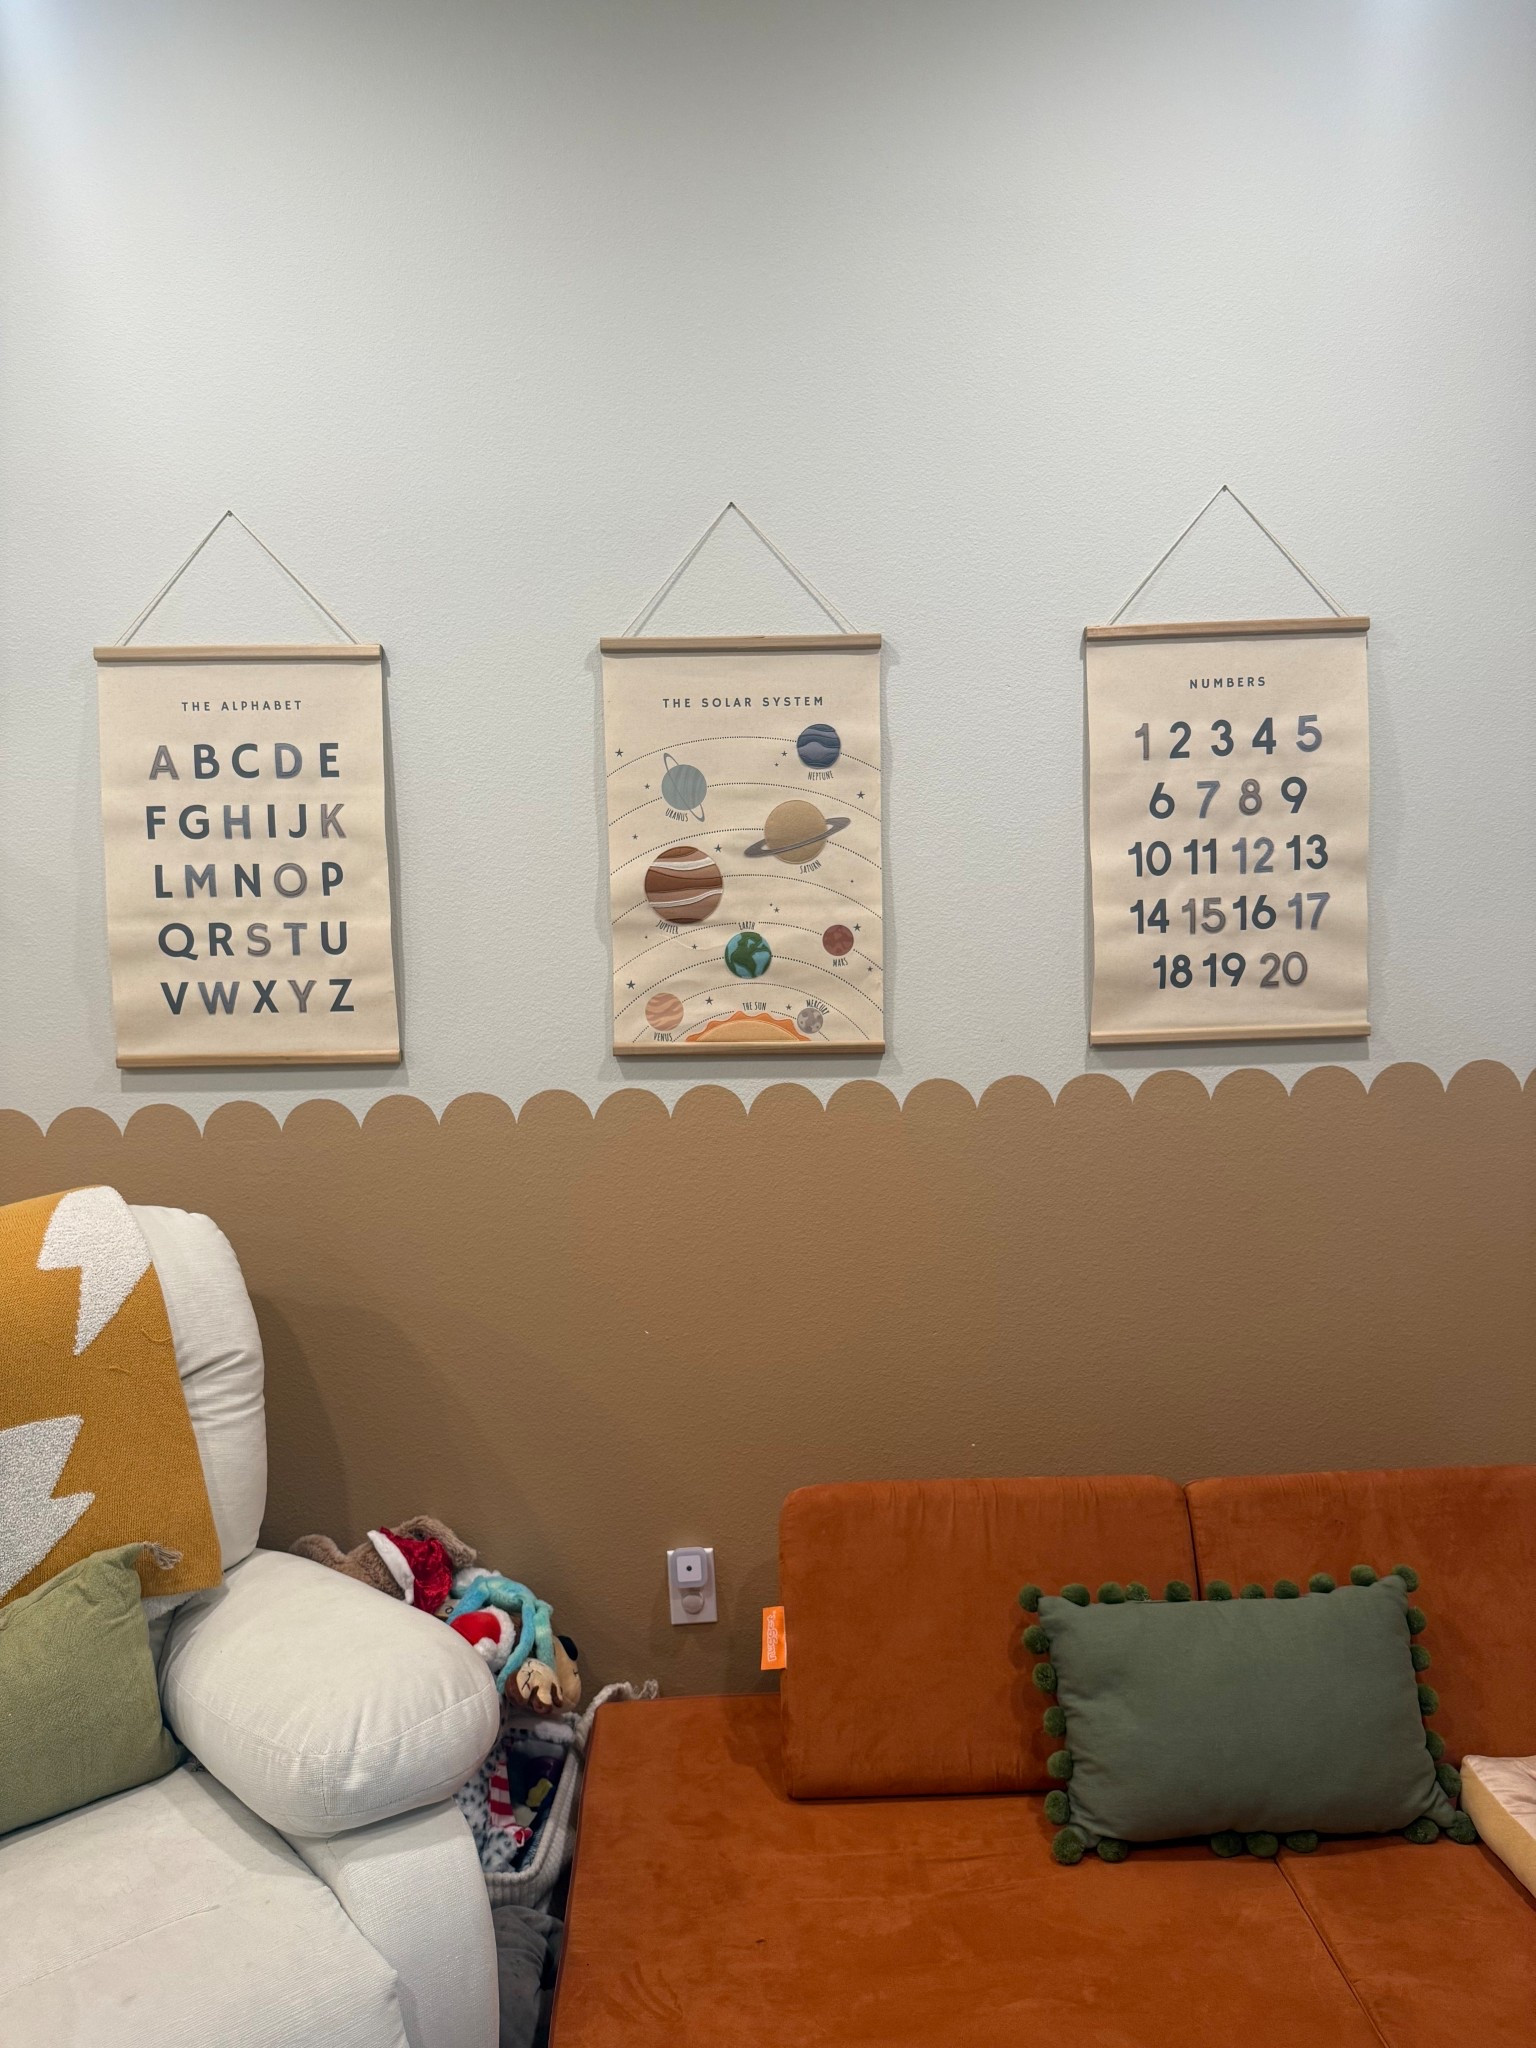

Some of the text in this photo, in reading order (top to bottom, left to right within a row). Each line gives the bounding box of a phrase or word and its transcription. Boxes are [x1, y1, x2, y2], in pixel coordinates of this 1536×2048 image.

[1189, 676, 1266, 690] NUMBERS
[181, 700, 302, 712] THE ALPHABET
[662, 695, 823, 709] THE SOLAR SYSTEM
[1134, 714, 1323, 762] 1 2 3 4 5
[808, 770, 834, 781] NEPTUNE
[1148, 775, 1308, 820] 6 7 8 9
[665, 808, 689, 822] URANUS
[1127, 833, 1329, 878] 10 11 12 13
[799, 859, 822, 875] SATURN
[1129, 891, 1331, 936] 14 15 16 17
[656, 919, 679, 935] JUPITER
[738, 921, 755, 931] EARTH
[832, 957, 849, 967] MARS
[1152, 950, 1309, 991] 18 19 20
[742, 1002, 767, 1011] THE SUN
[806, 999, 830, 1016] MERCURY
[653, 1031, 673, 1042] VENUS
